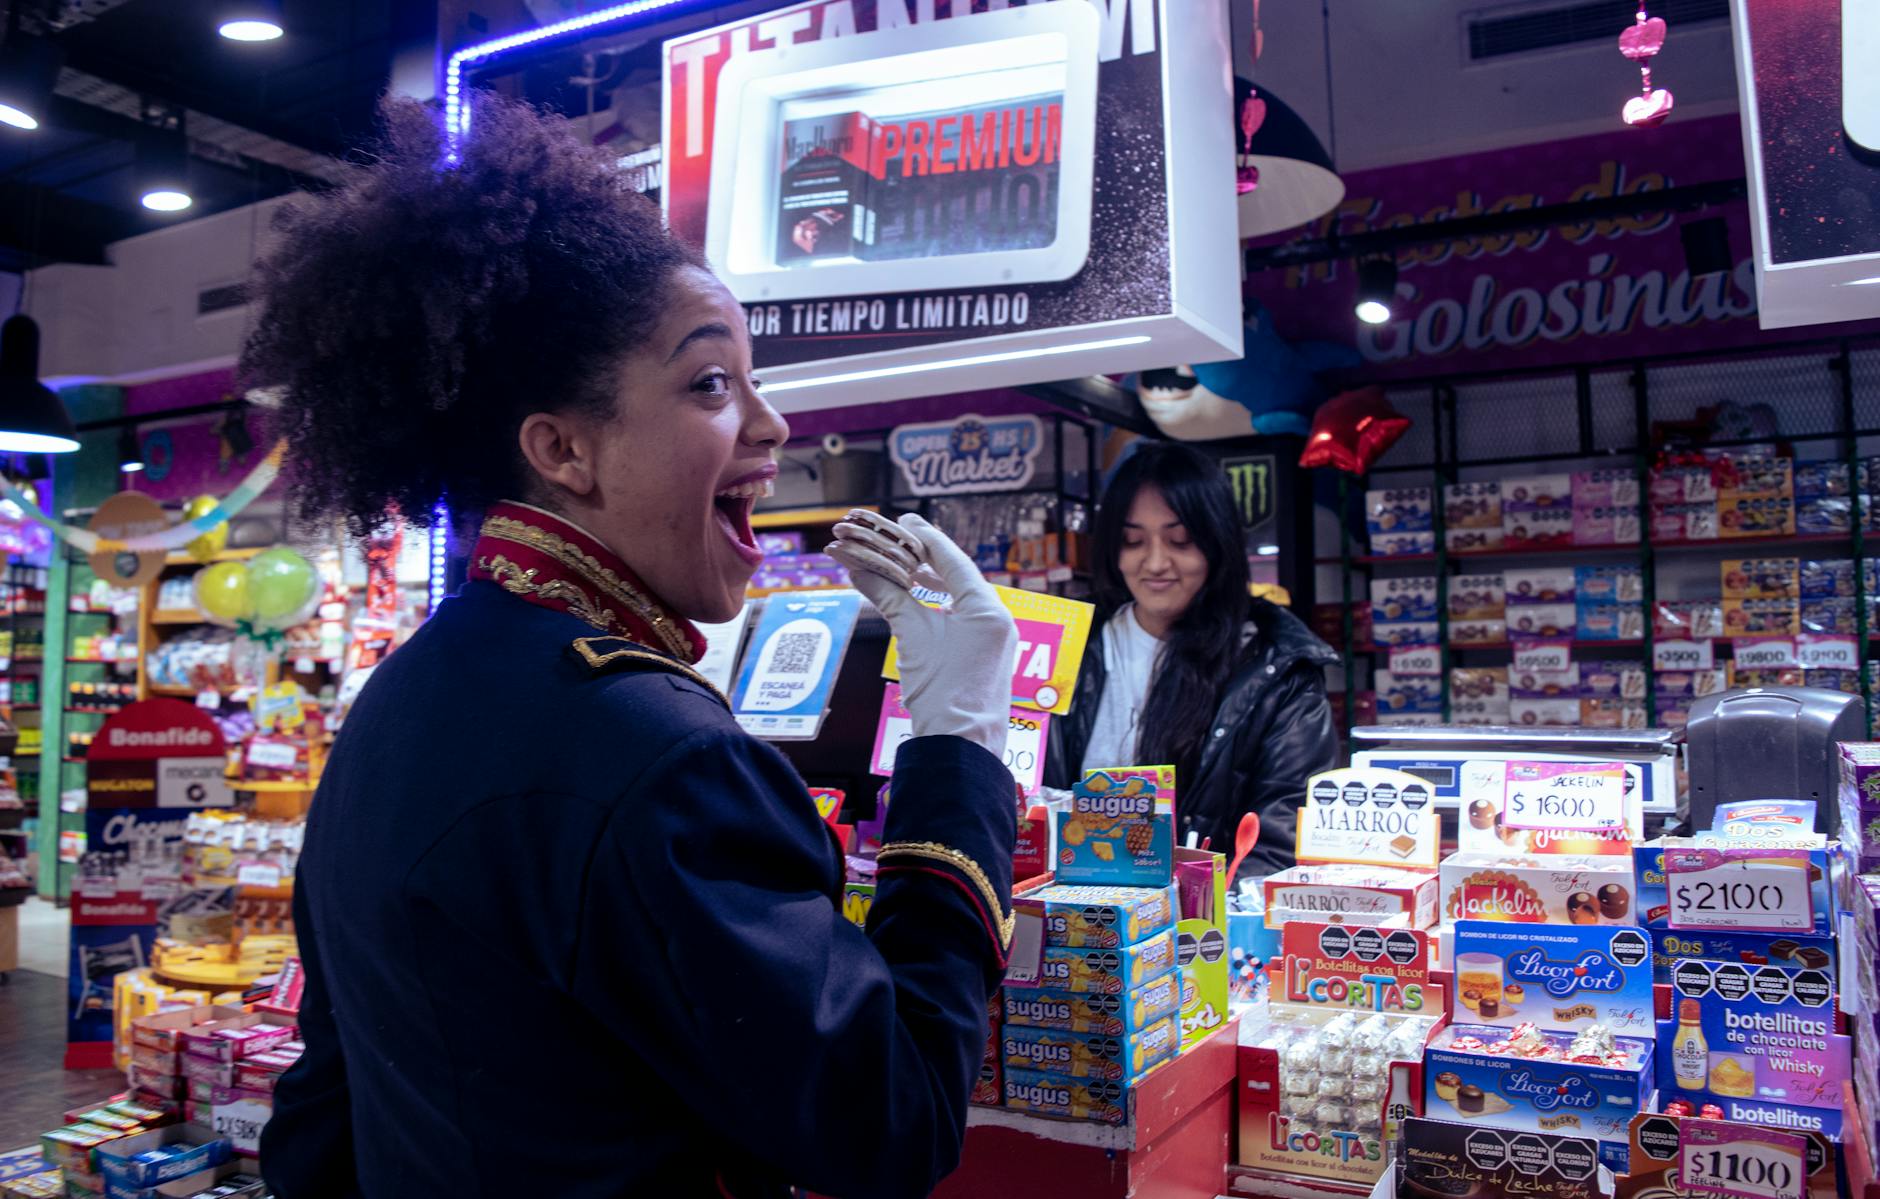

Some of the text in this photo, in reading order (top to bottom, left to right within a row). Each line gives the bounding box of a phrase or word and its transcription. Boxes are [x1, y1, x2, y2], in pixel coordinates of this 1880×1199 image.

[792, 298, 886, 335] TIEMPO
[896, 291, 1030, 330] LIMITADO
[903, 434, 949, 454] OPEN
[912, 446, 1022, 486] Market
[109, 727, 213, 746] Bonafide
[1551, 775, 1604, 788] JACKELIN
[1077, 796, 1150, 819] sugus
[1512, 791, 1595, 818] $ 1600
[1314, 808, 1419, 836] MARROC
[1723, 822, 1785, 838] Dos
[1282, 893, 1351, 913] MARROC
[1676, 882, 1784, 913] $2100
[80, 904, 147, 916] Bonafide
[1529, 935, 1578, 943] CRISTALIZADO
[1663, 936, 1704, 954] Dos
[1315, 959, 1424, 978] Botellitas con licor
[1143, 982, 1170, 1007] sugus
[1006, 1001, 1071, 1020] sugus
[1556, 1006, 1595, 1020] WHISKY
[1725, 1007, 1828, 1036] botellitas
[1142, 1026, 1169, 1050] sugus
[1726, 1030, 1828, 1051] de chocolate
[1005, 1042, 1071, 1062] sugus
[1744, 1046, 1794, 1058] con licor
[1432, 1054, 1511, 1070] BOMBONES DE LICOR
[1768, 1057, 1825, 1078] Whisky
[1005, 1083, 1070, 1106] sugus
[1540, 1116, 1579, 1128] WHISKY
[1731, 1103, 1823, 1130] botellitas
[1641, 1130, 1679, 1140] EXCESO EN
[1470, 1142, 1494, 1150] EXCESO
[1512, 1143, 1537, 1152] EXCESO
[1516, 1150, 1543, 1158] GRASAS
[1260, 1152, 1294, 1165] Botellitas
[1311, 1159, 1328, 1169] licor
[1555, 1152, 1581, 1160] EXCESO
[1425, 1163, 1553, 1194] Dulce de Leche
[1690, 1150, 1791, 1190] $1100
